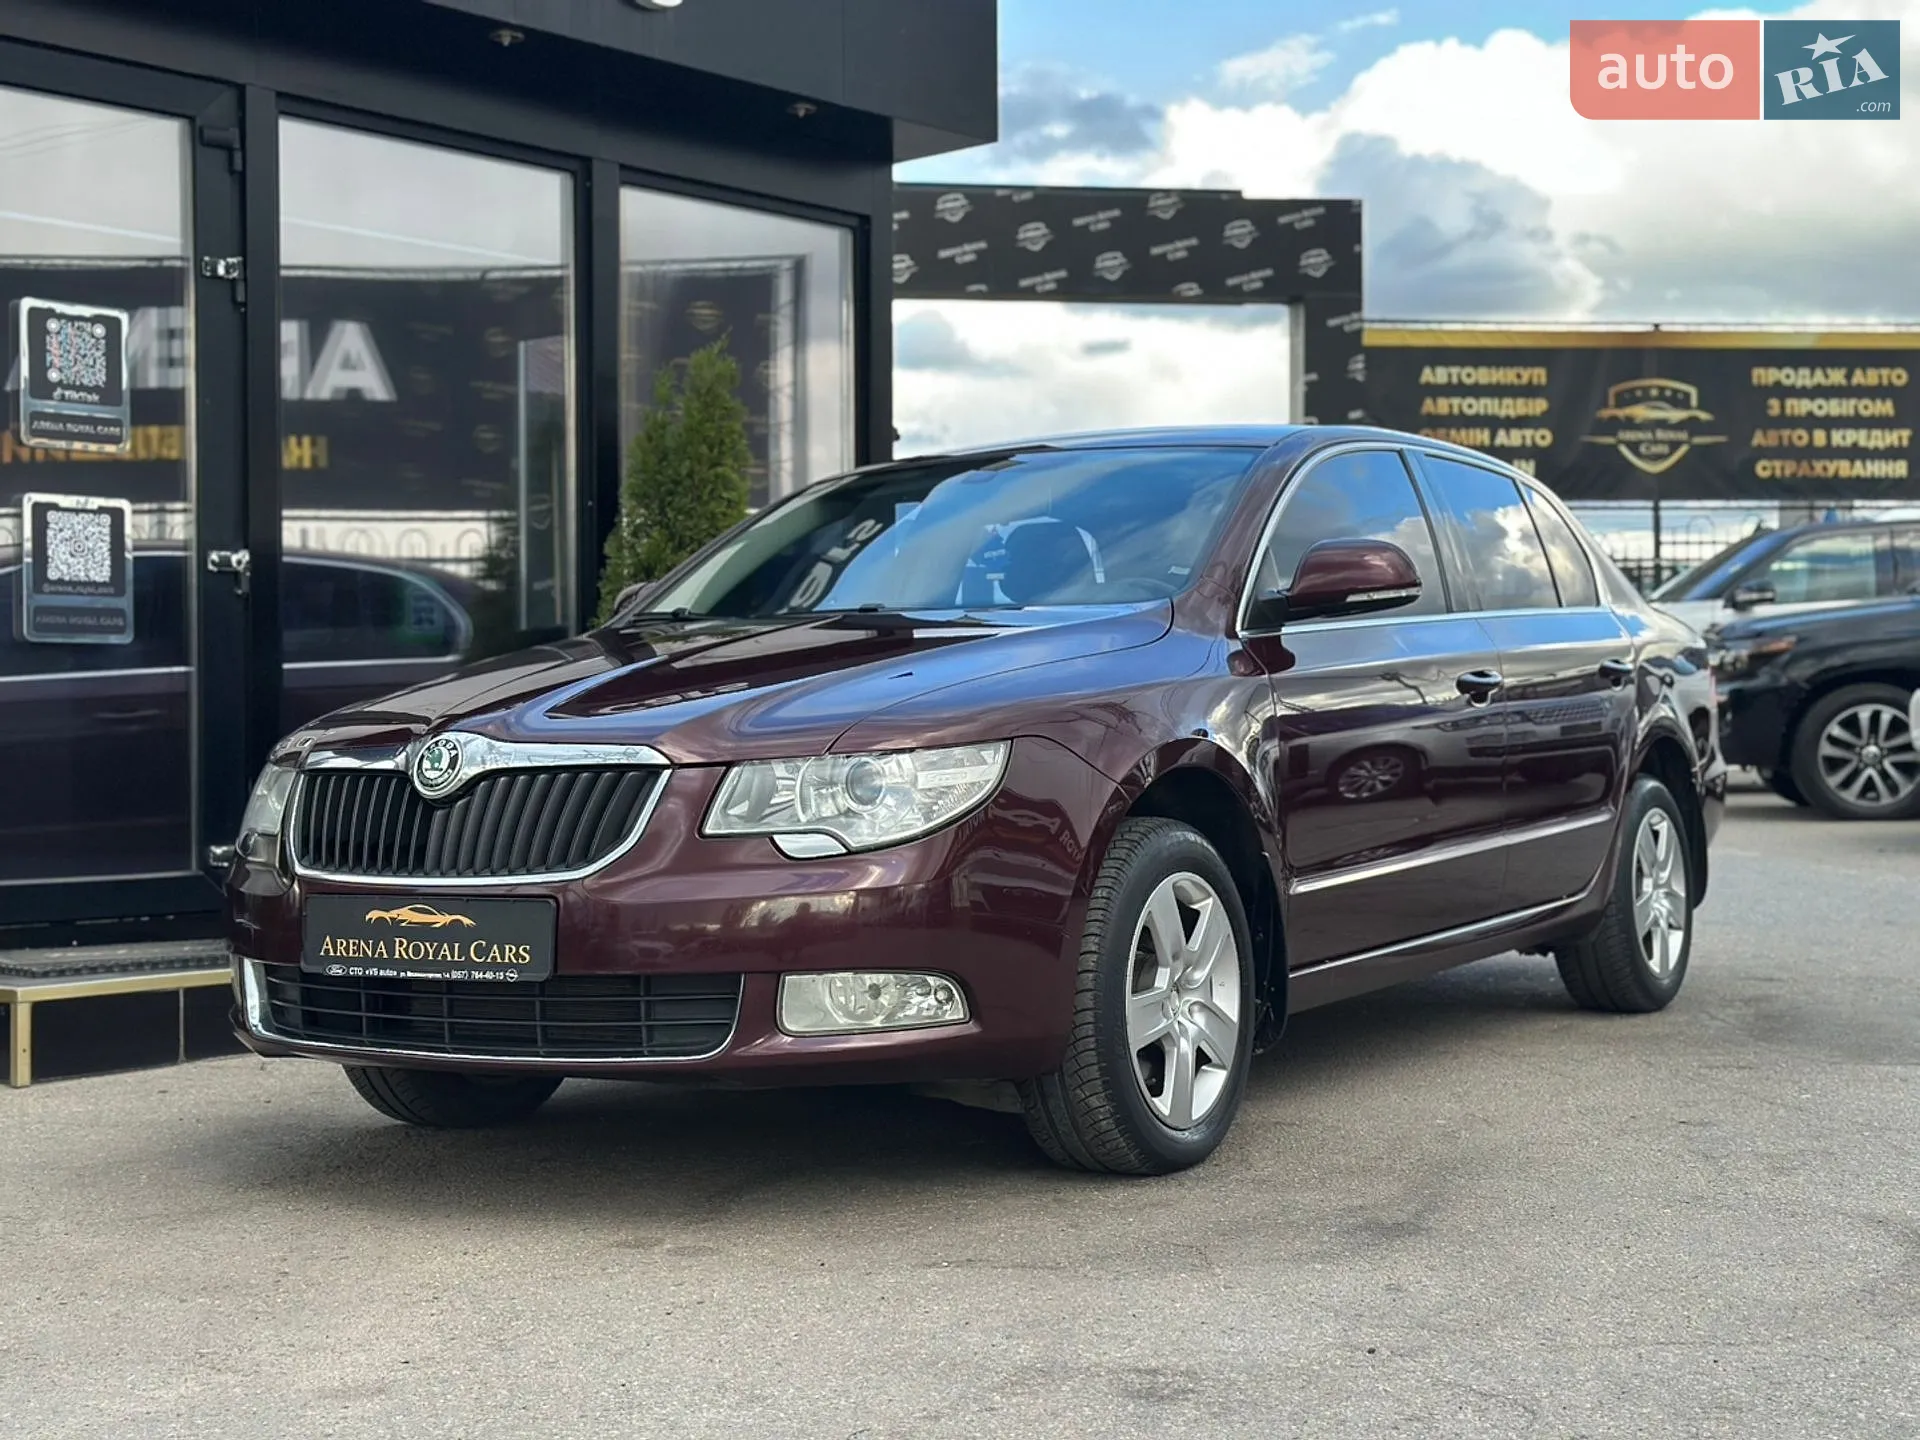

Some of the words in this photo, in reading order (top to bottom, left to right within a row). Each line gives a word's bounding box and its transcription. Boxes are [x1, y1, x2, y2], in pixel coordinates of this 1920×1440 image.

[1419, 365, 1548, 386] АВТОВИКУП
[1751, 366, 1848, 389] ПРОДАЖ
[1851, 366, 1909, 387] АВТО
[1420, 396, 1549, 419] АВТОПІДБІР
[1784, 397, 1895, 418] ПРОБІГОМ
[1494, 427, 1553, 448] АВТО
[1751, 428, 1810, 448] АВТО
[1830, 428, 1912, 450] КРЕДИТ
[1754, 458, 1909, 478] СТРАХУВАННЯ
[319, 935, 389, 959] ARENA
[394, 937, 466, 962] ROYAL
[470, 940, 531, 964] CARS
